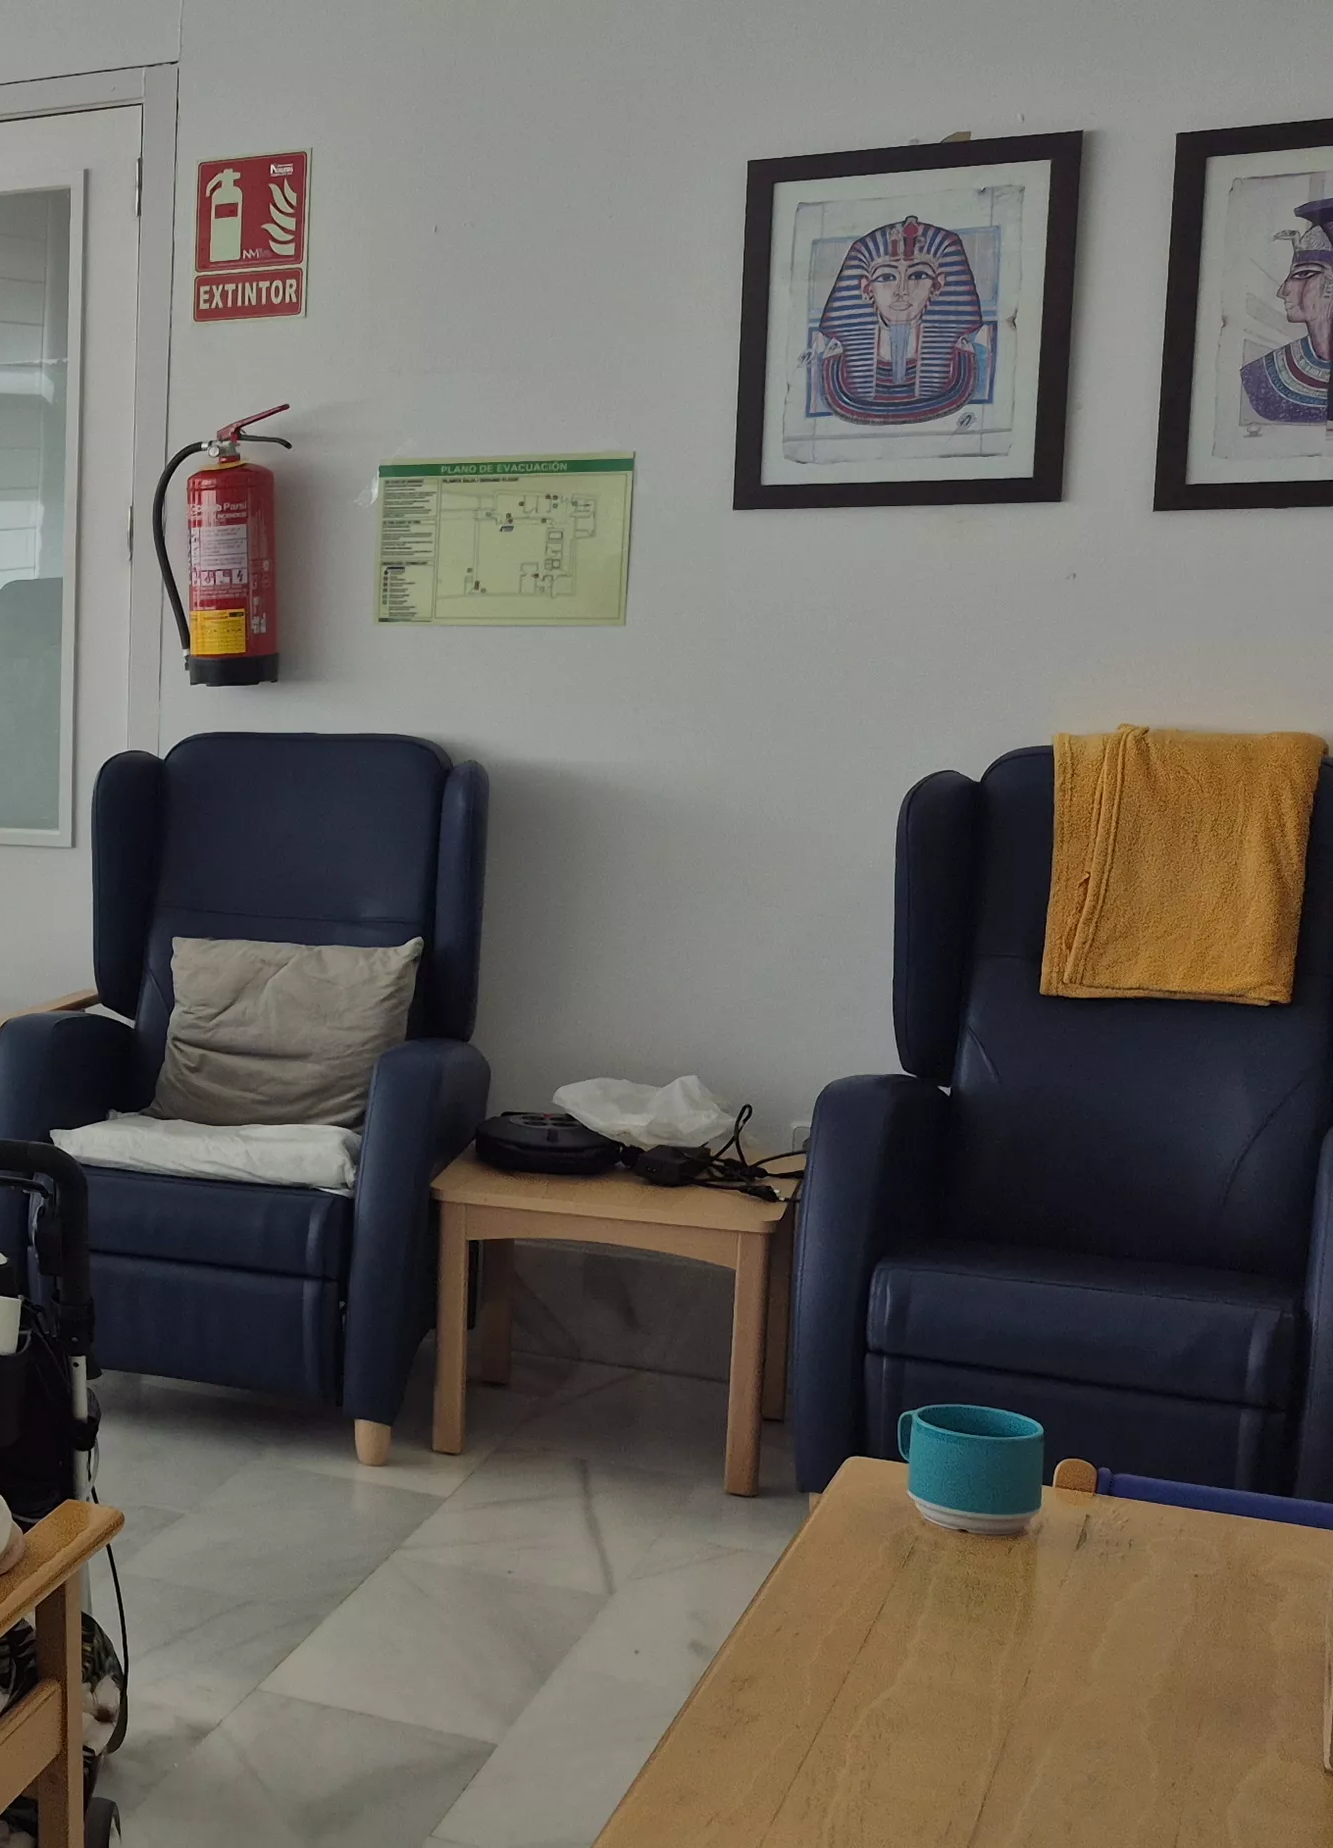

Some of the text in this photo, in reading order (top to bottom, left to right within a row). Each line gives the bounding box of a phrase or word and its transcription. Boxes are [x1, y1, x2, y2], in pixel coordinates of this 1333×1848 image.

[199, 279, 297, 309] EXTINTOR
[441, 461, 568, 474] PLANO DE EVACUACIÓN
